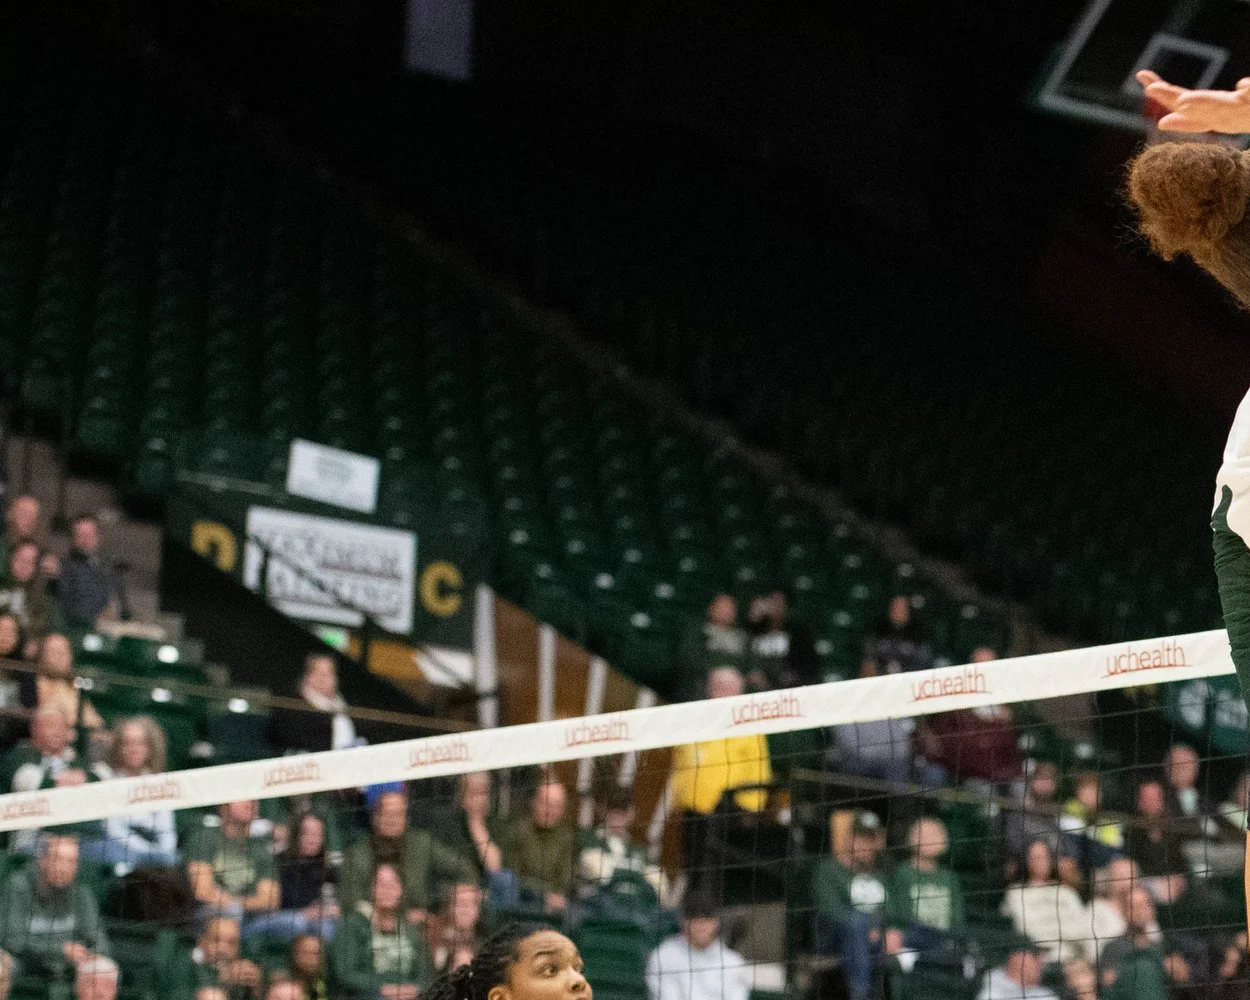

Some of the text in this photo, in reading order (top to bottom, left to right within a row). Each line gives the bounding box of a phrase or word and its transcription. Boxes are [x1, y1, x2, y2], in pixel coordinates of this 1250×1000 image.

[419, 560, 465, 617] C
[1105, 641, 1184, 675] uchealth
[911, 669, 985, 700] uchealth
[731, 694, 800, 722] uchealth
[564, 719, 630, 746] uchealth
[409, 740, 470, 766] uchealth
